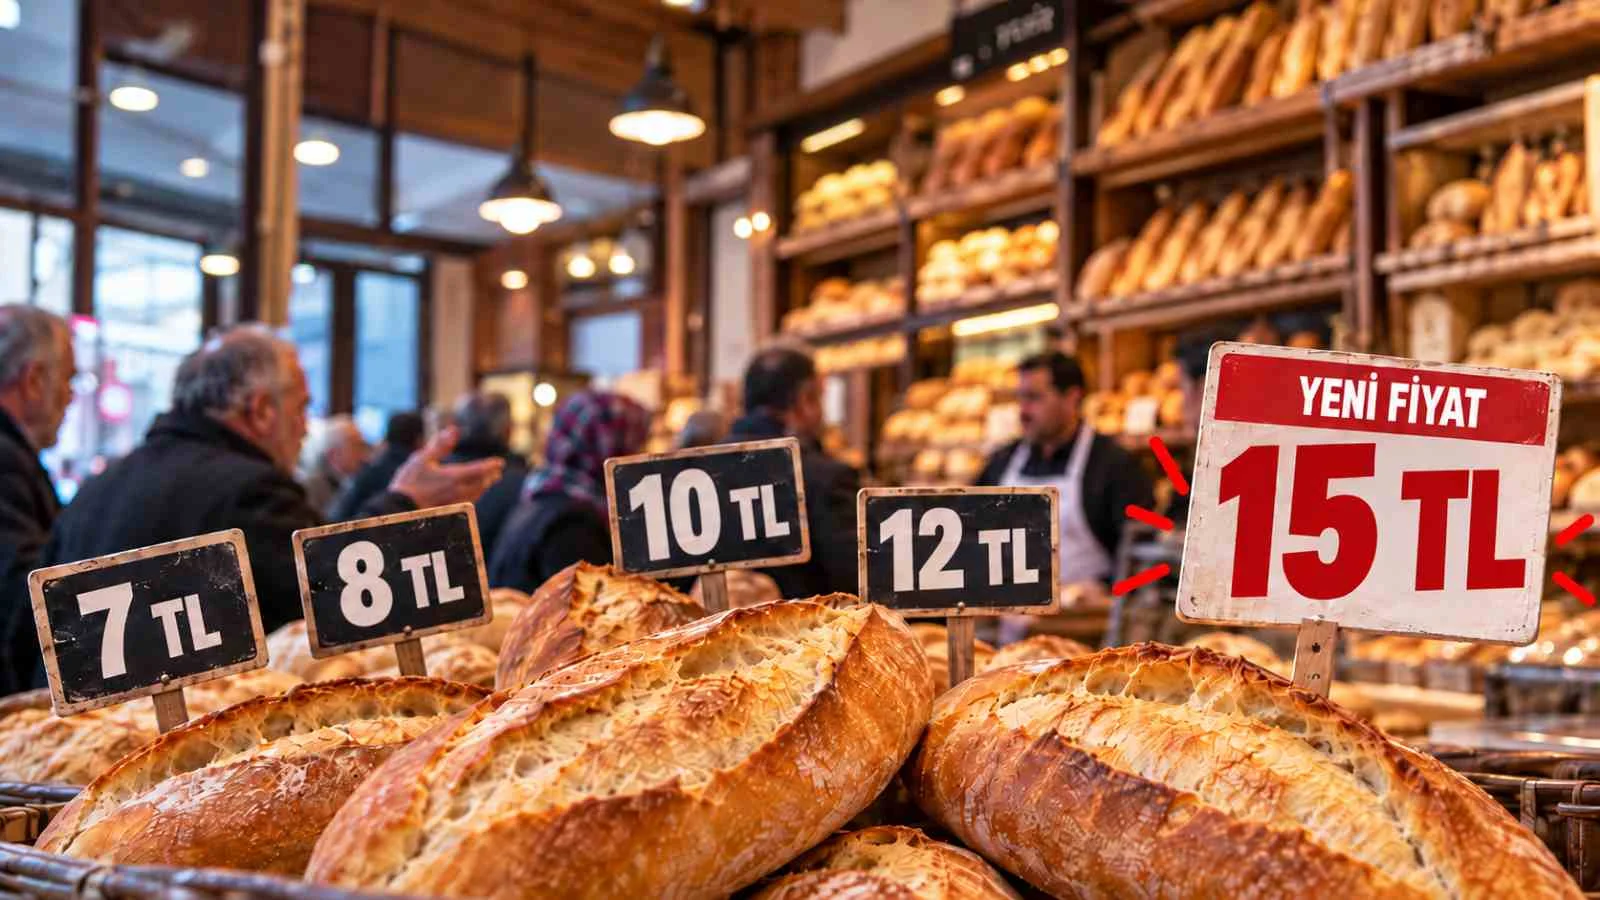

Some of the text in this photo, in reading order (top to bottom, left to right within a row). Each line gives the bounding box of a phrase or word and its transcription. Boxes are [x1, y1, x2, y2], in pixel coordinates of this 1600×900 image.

[1300, 371, 1488, 428] YENİ FİYAT
[628, 468, 790, 562] 10 TL
[879, 507, 1039, 593] 12 TL
[1217, 442, 1526, 600] 15 TL
[336, 540, 464, 628] 8 TL
[78, 582, 222, 680] 7 TL
